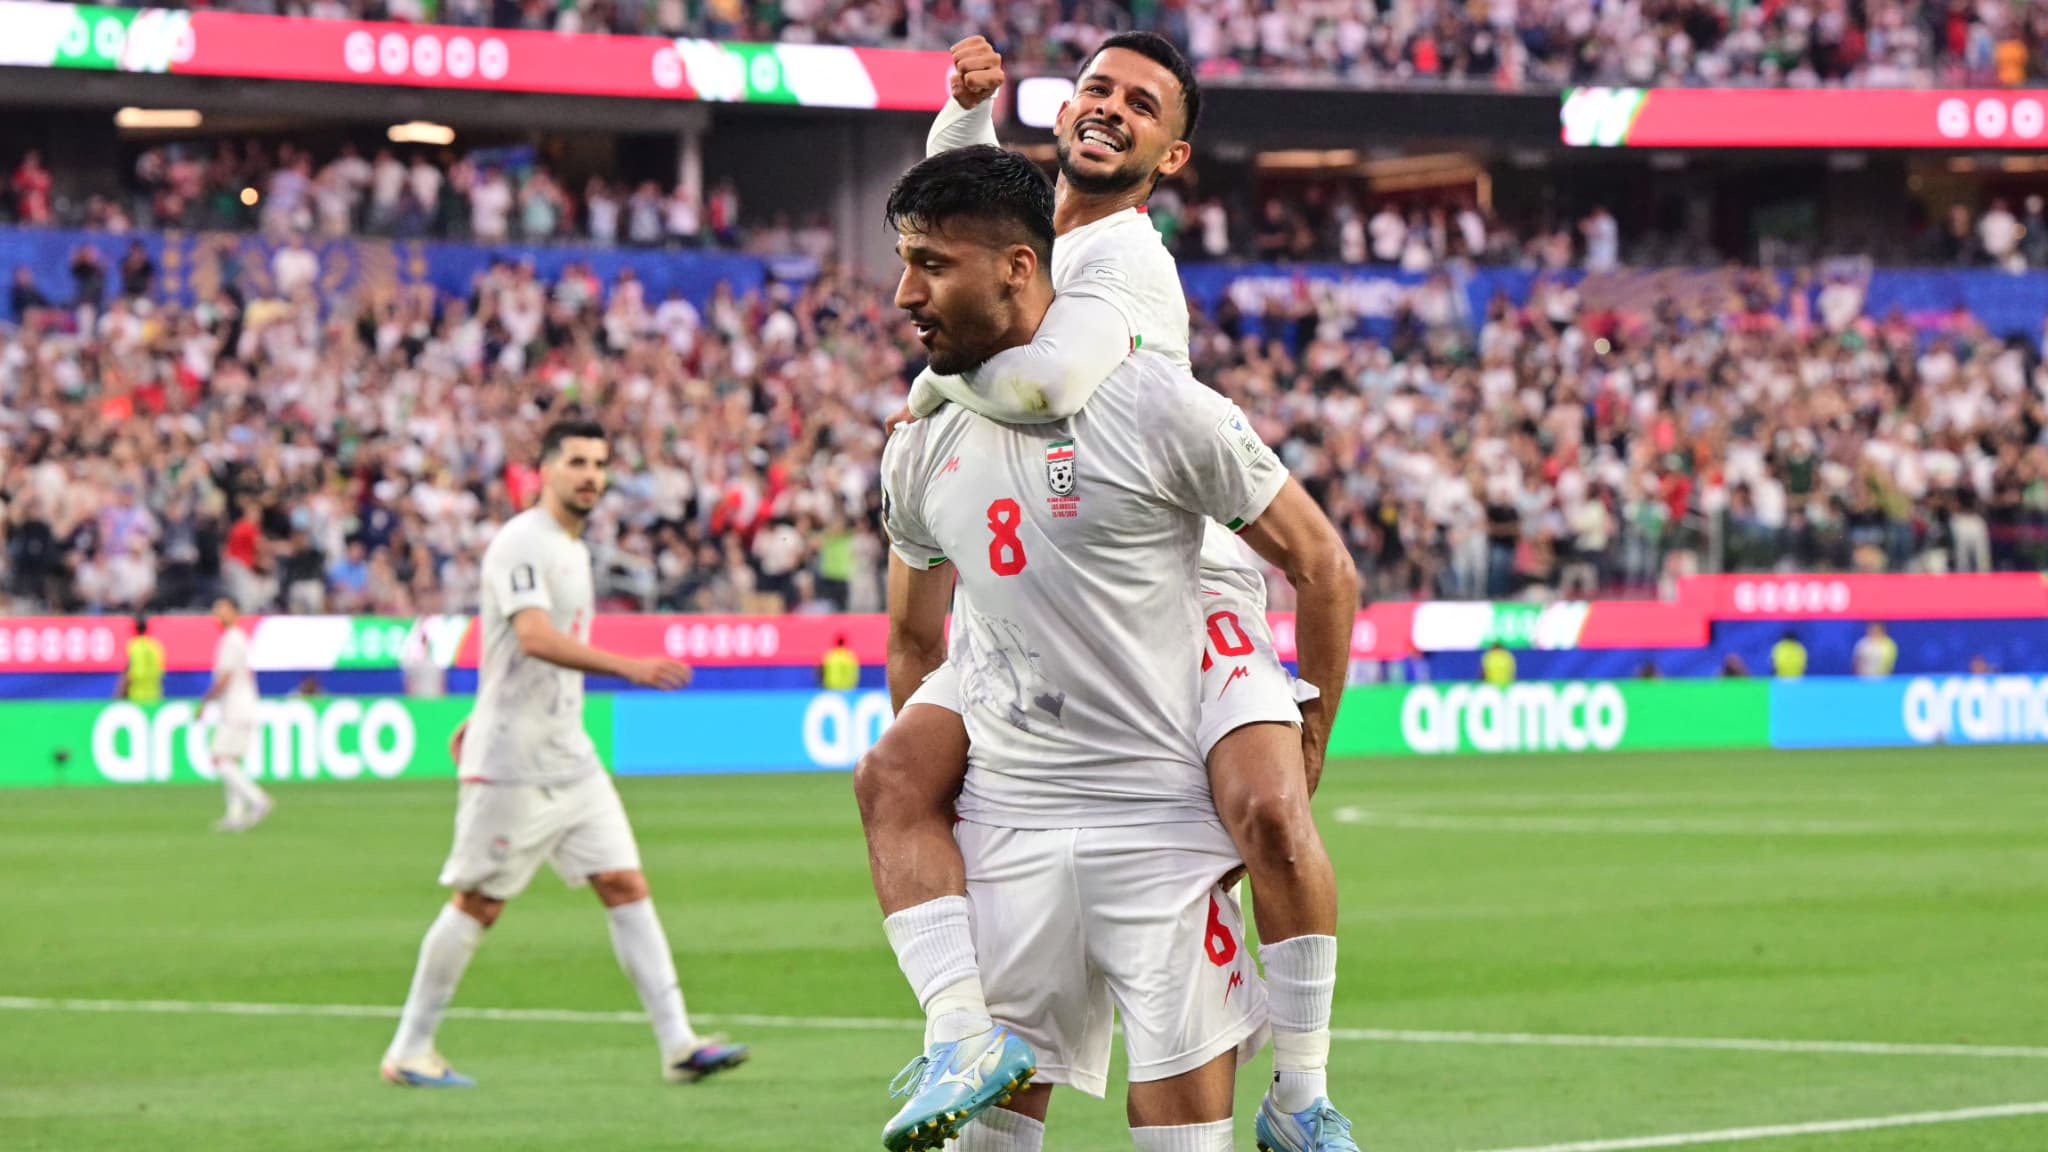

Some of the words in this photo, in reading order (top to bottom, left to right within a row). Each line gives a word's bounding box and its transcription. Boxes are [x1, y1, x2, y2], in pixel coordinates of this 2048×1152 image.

[986, 497, 1028, 577] 8
[1202, 611, 1255, 672] 0
[1402, 681, 1627, 753] aramco
